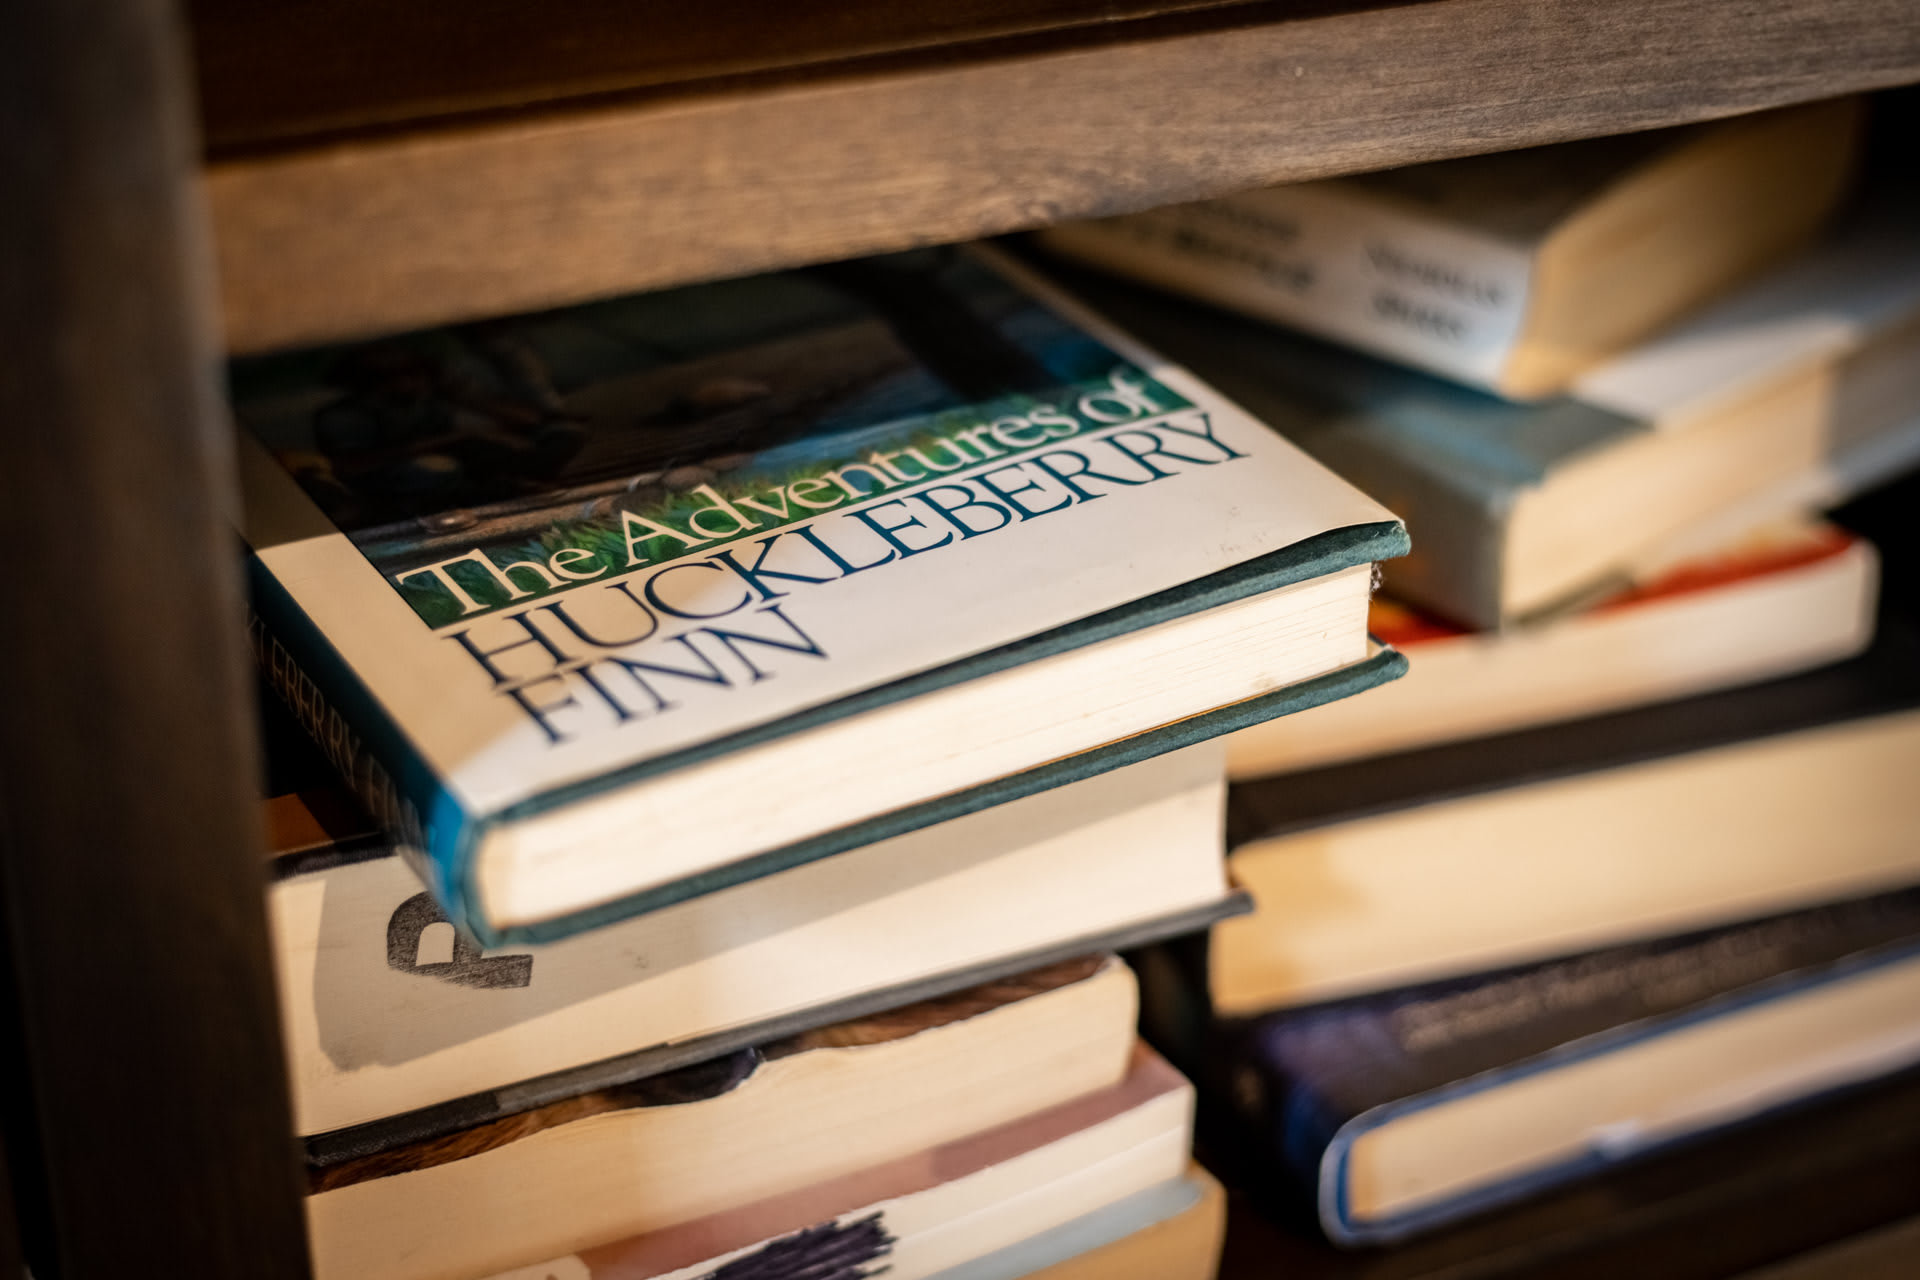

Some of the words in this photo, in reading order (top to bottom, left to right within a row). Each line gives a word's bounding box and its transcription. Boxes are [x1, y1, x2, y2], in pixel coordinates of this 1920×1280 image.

[394, 547, 608, 616] The
[620, 404, 1080, 567] Adventures
[1078, 368, 1162, 424] of
[441, 411, 1252, 692] HUCKLEBERRY
[496, 603, 829, 745] FINN
